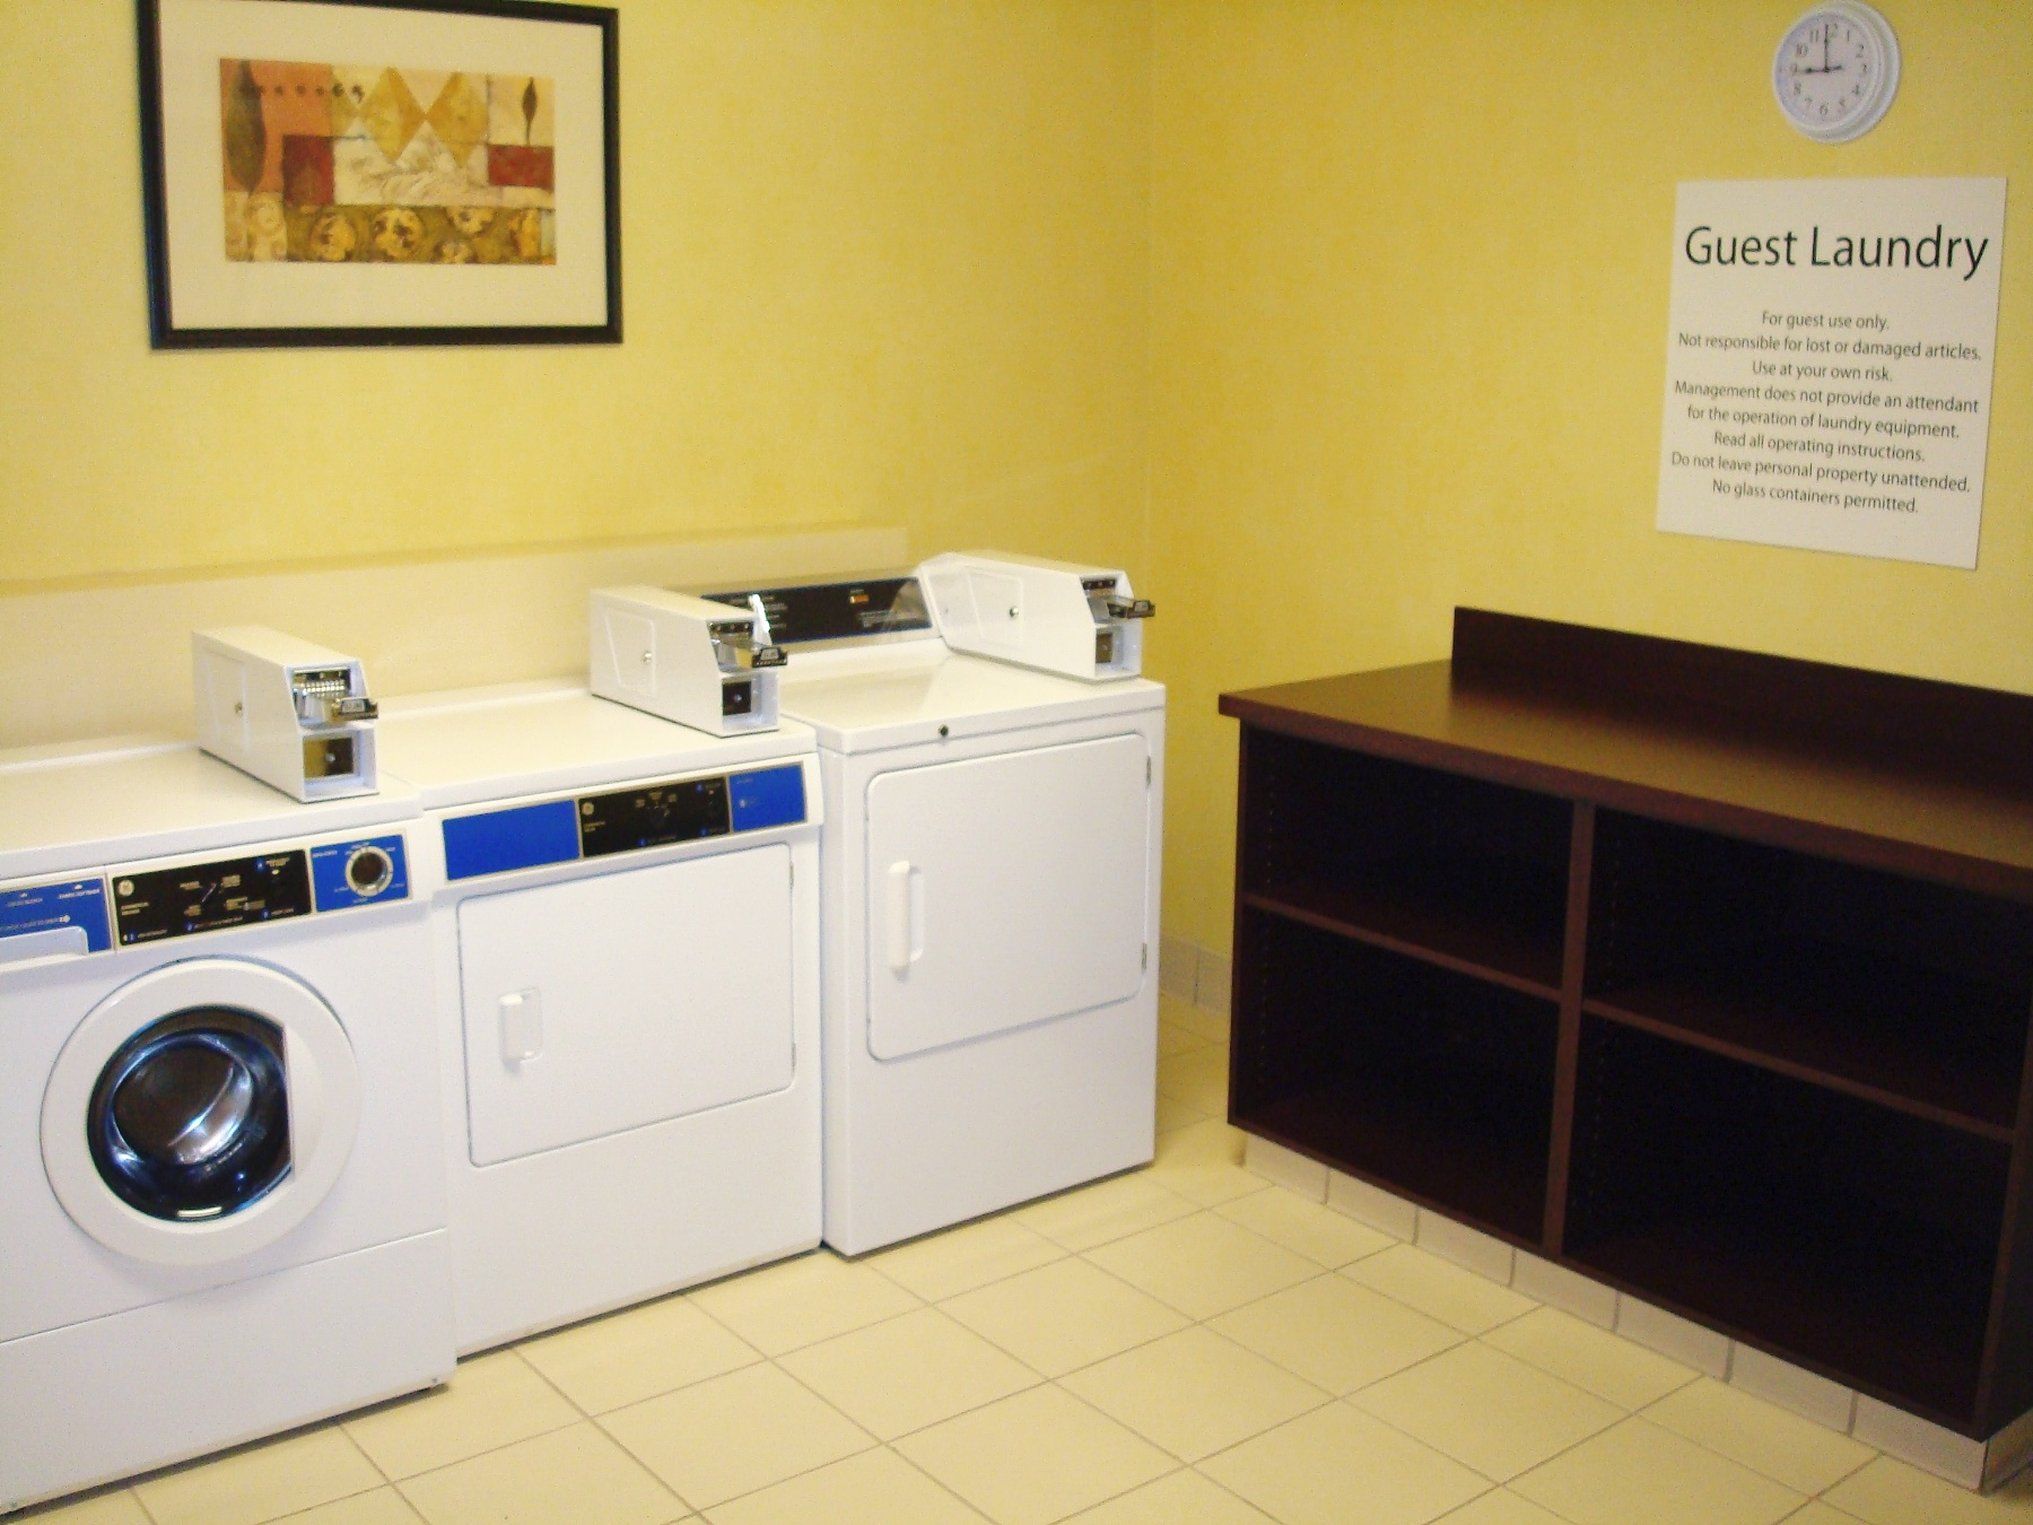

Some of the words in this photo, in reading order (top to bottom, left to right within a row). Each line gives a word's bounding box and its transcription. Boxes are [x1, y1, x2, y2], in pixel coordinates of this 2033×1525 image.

[1810, 29, 1819, 43] 11
[1846, 29, 1851, 42] 1
[1855, 44, 1865, 59] 2
[1685, 225, 1798, 267] Guest
[1811, 224, 1990, 281] Laundry
[1762, 310, 1783, 325] For
[1786, 313, 1824, 329] guest
[1828, 315, 1852, 328] use
[1855, 314, 1890, 332] only.
[1679, 332, 1701, 347] Not
[1705, 335, 1780, 351] responsible
[1784, 336, 1803, 351] for
[1807, 338, 1830, 352] lost
[1834, 341, 1849, 353] or
[1853, 339, 1921, 360] damaged
[1925, 343, 1981, 361] articles.
[1752, 360, 1776, 375] Use
[1780, 363, 1793, 376] at
[1796, 365, 1827, 380] your
[1830, 367, 1861, 380] own
[1865, 366, 1893, 382] risk.
[1675, 380, 1760, 400] Management
[1764, 386, 1796, 401] does
[1800, 390, 1823, 403] not
[1827, 391, 1881, 407] provide
[1884, 396, 1901, 408] an
[1905, 395, 1978, 413] attendant
[1687, 404, 1705, 419] for
[1709, 407, 1730, 422] the
[1733, 410, 1797, 426] operation
[1800, 413, 1815, 427] of
[1818, 414, 1872, 435] laundry
[1875, 419, 1959, 438] equipment.
[1714, 431, 1746, 447] Read
[1749, 434, 1765, 449] all
[1768, 437, 1834, 458] operating
[1838, 440, 1925, 461] instructions.
[1671, 451, 1690, 466] Do
[1693, 455, 1715, 468] not
[1718, 456, 1751, 471] leave
[1755, 462, 1813, 478] personal
[1816, 467, 1878, 486] property
[1881, 472, 1970, 492] unattended.
[1712, 478, 1731, 494] No
[1734, 481, 1766, 499] glass
[1769, 486, 1840, 505] containers
[1844, 492, 1919, 513] permitted.
